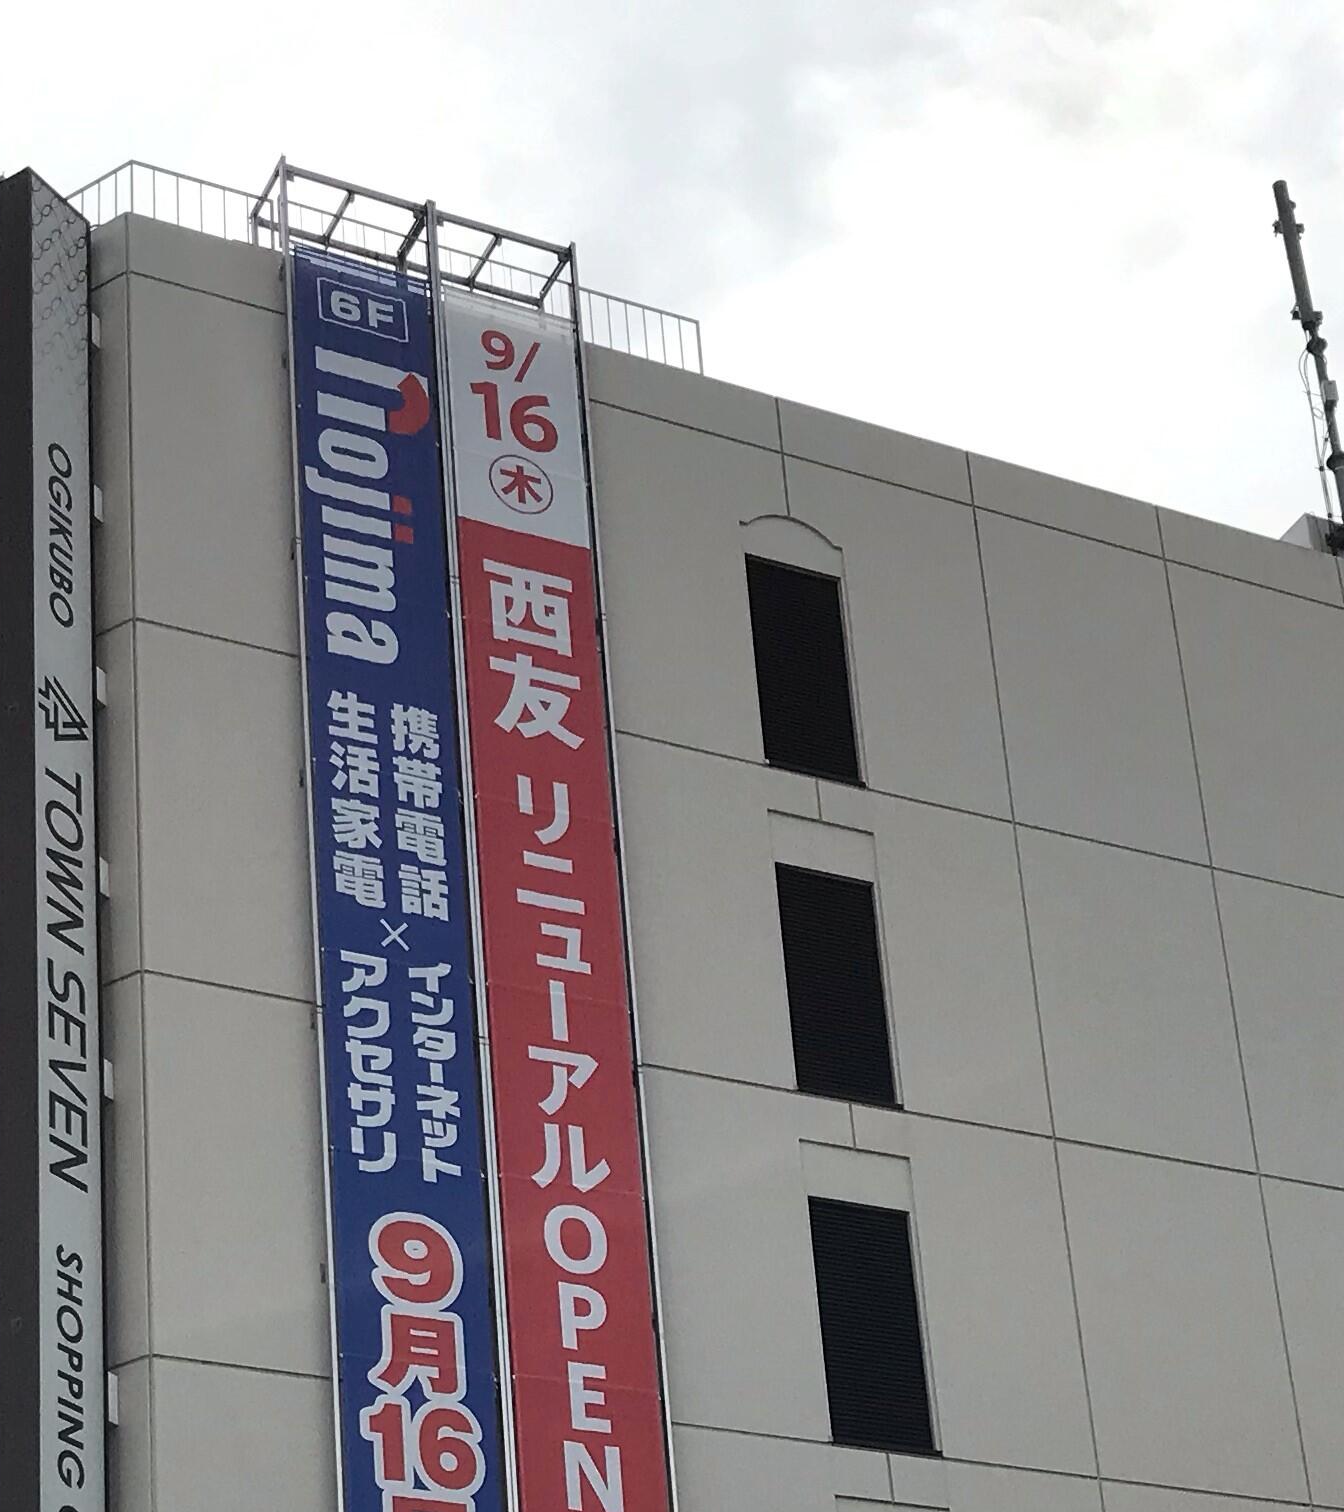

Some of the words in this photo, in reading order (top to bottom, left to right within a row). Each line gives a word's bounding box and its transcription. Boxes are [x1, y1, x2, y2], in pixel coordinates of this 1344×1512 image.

[329, 290, 396, 330] 6F
[470, 380, 559, 454] 16
[47, 443, 75, 629] OGIKUBO
[37, 770, 88, 956] TOWN
[47, 971, 89, 1193] SEVEN
[54, 1243, 87, 1490] SHOPPING
